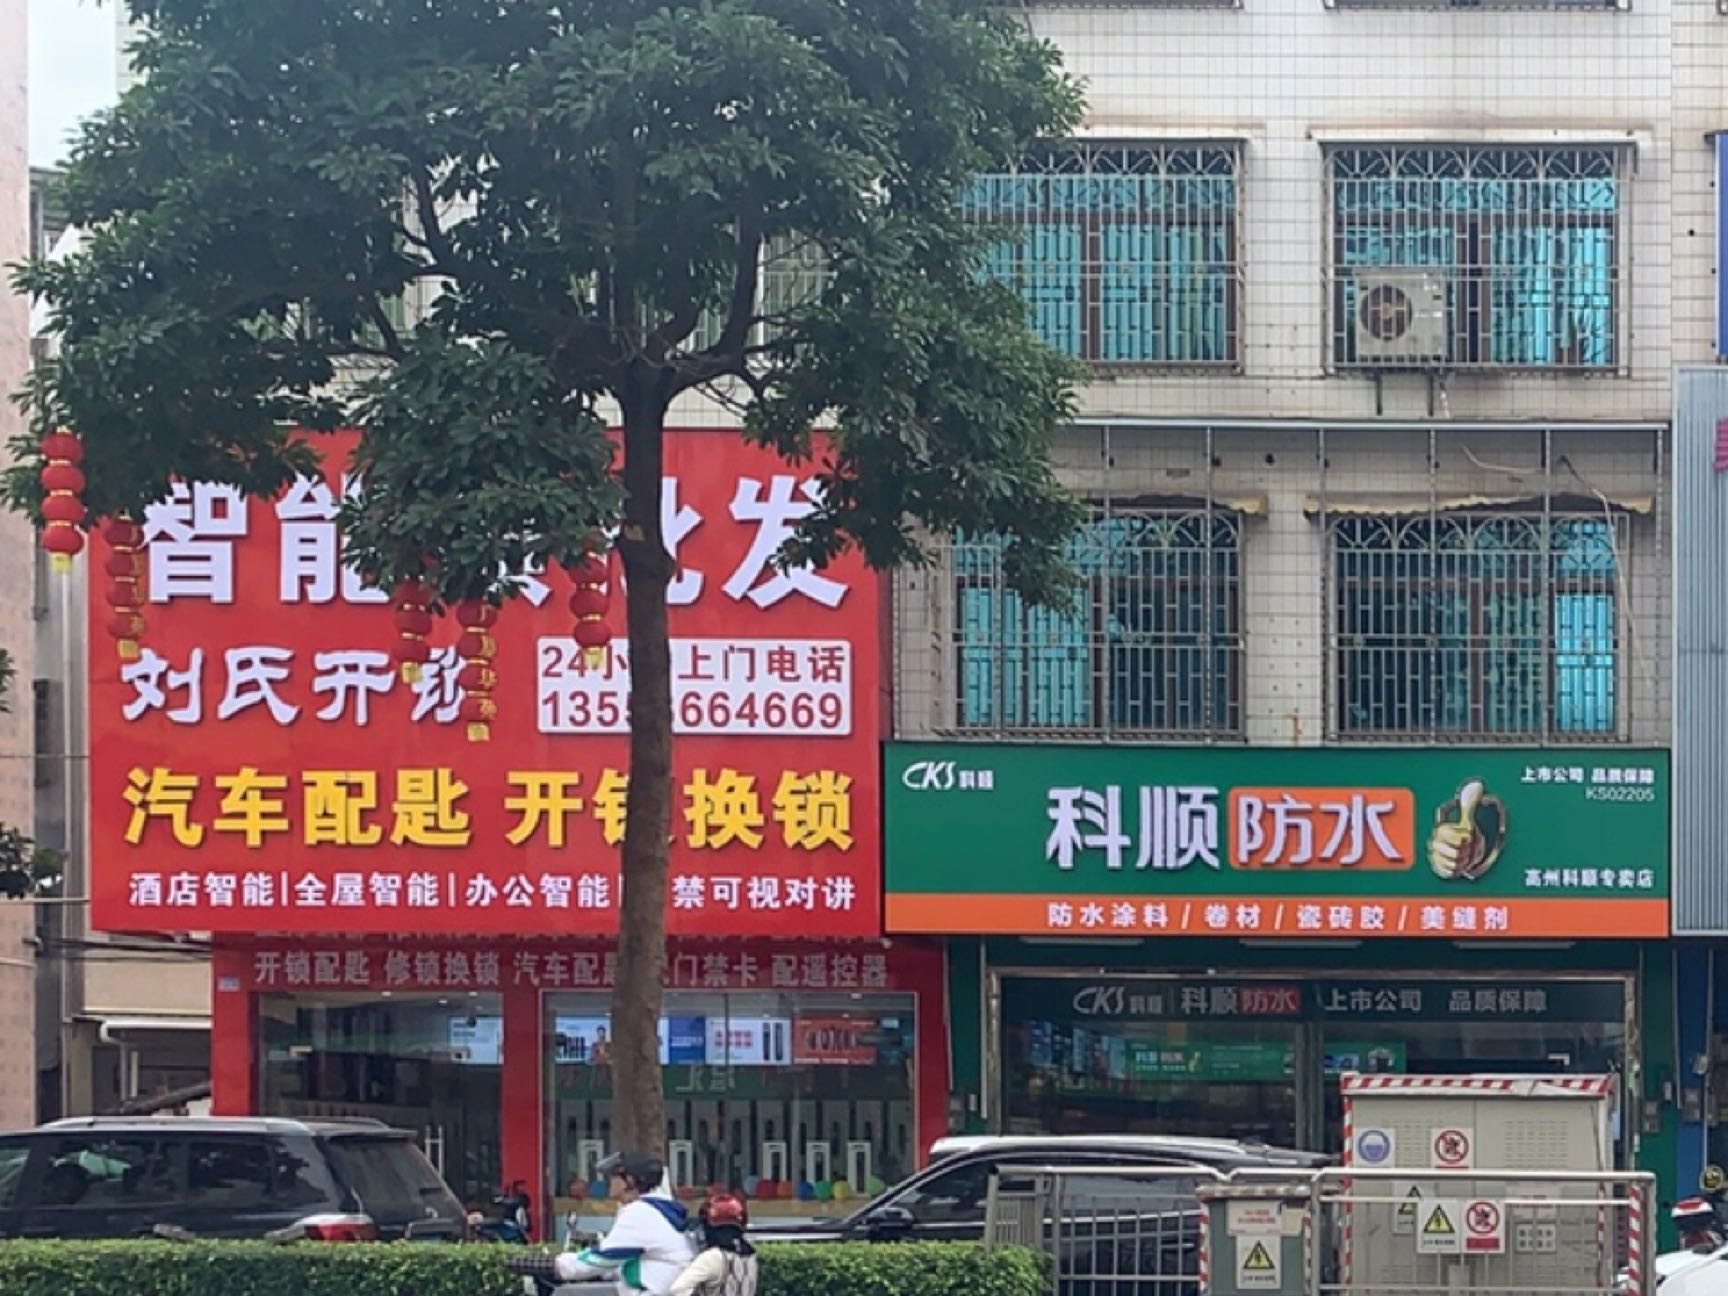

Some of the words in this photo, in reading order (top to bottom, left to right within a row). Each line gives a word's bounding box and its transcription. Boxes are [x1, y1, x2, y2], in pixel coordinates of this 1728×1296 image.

[541, 644, 845, 683] 24小上门电话
[541, 689, 844, 730] 135664669
[1520, 765, 1584, 784] 上市公司
[122, 766, 471, 848] 汽车配匙
